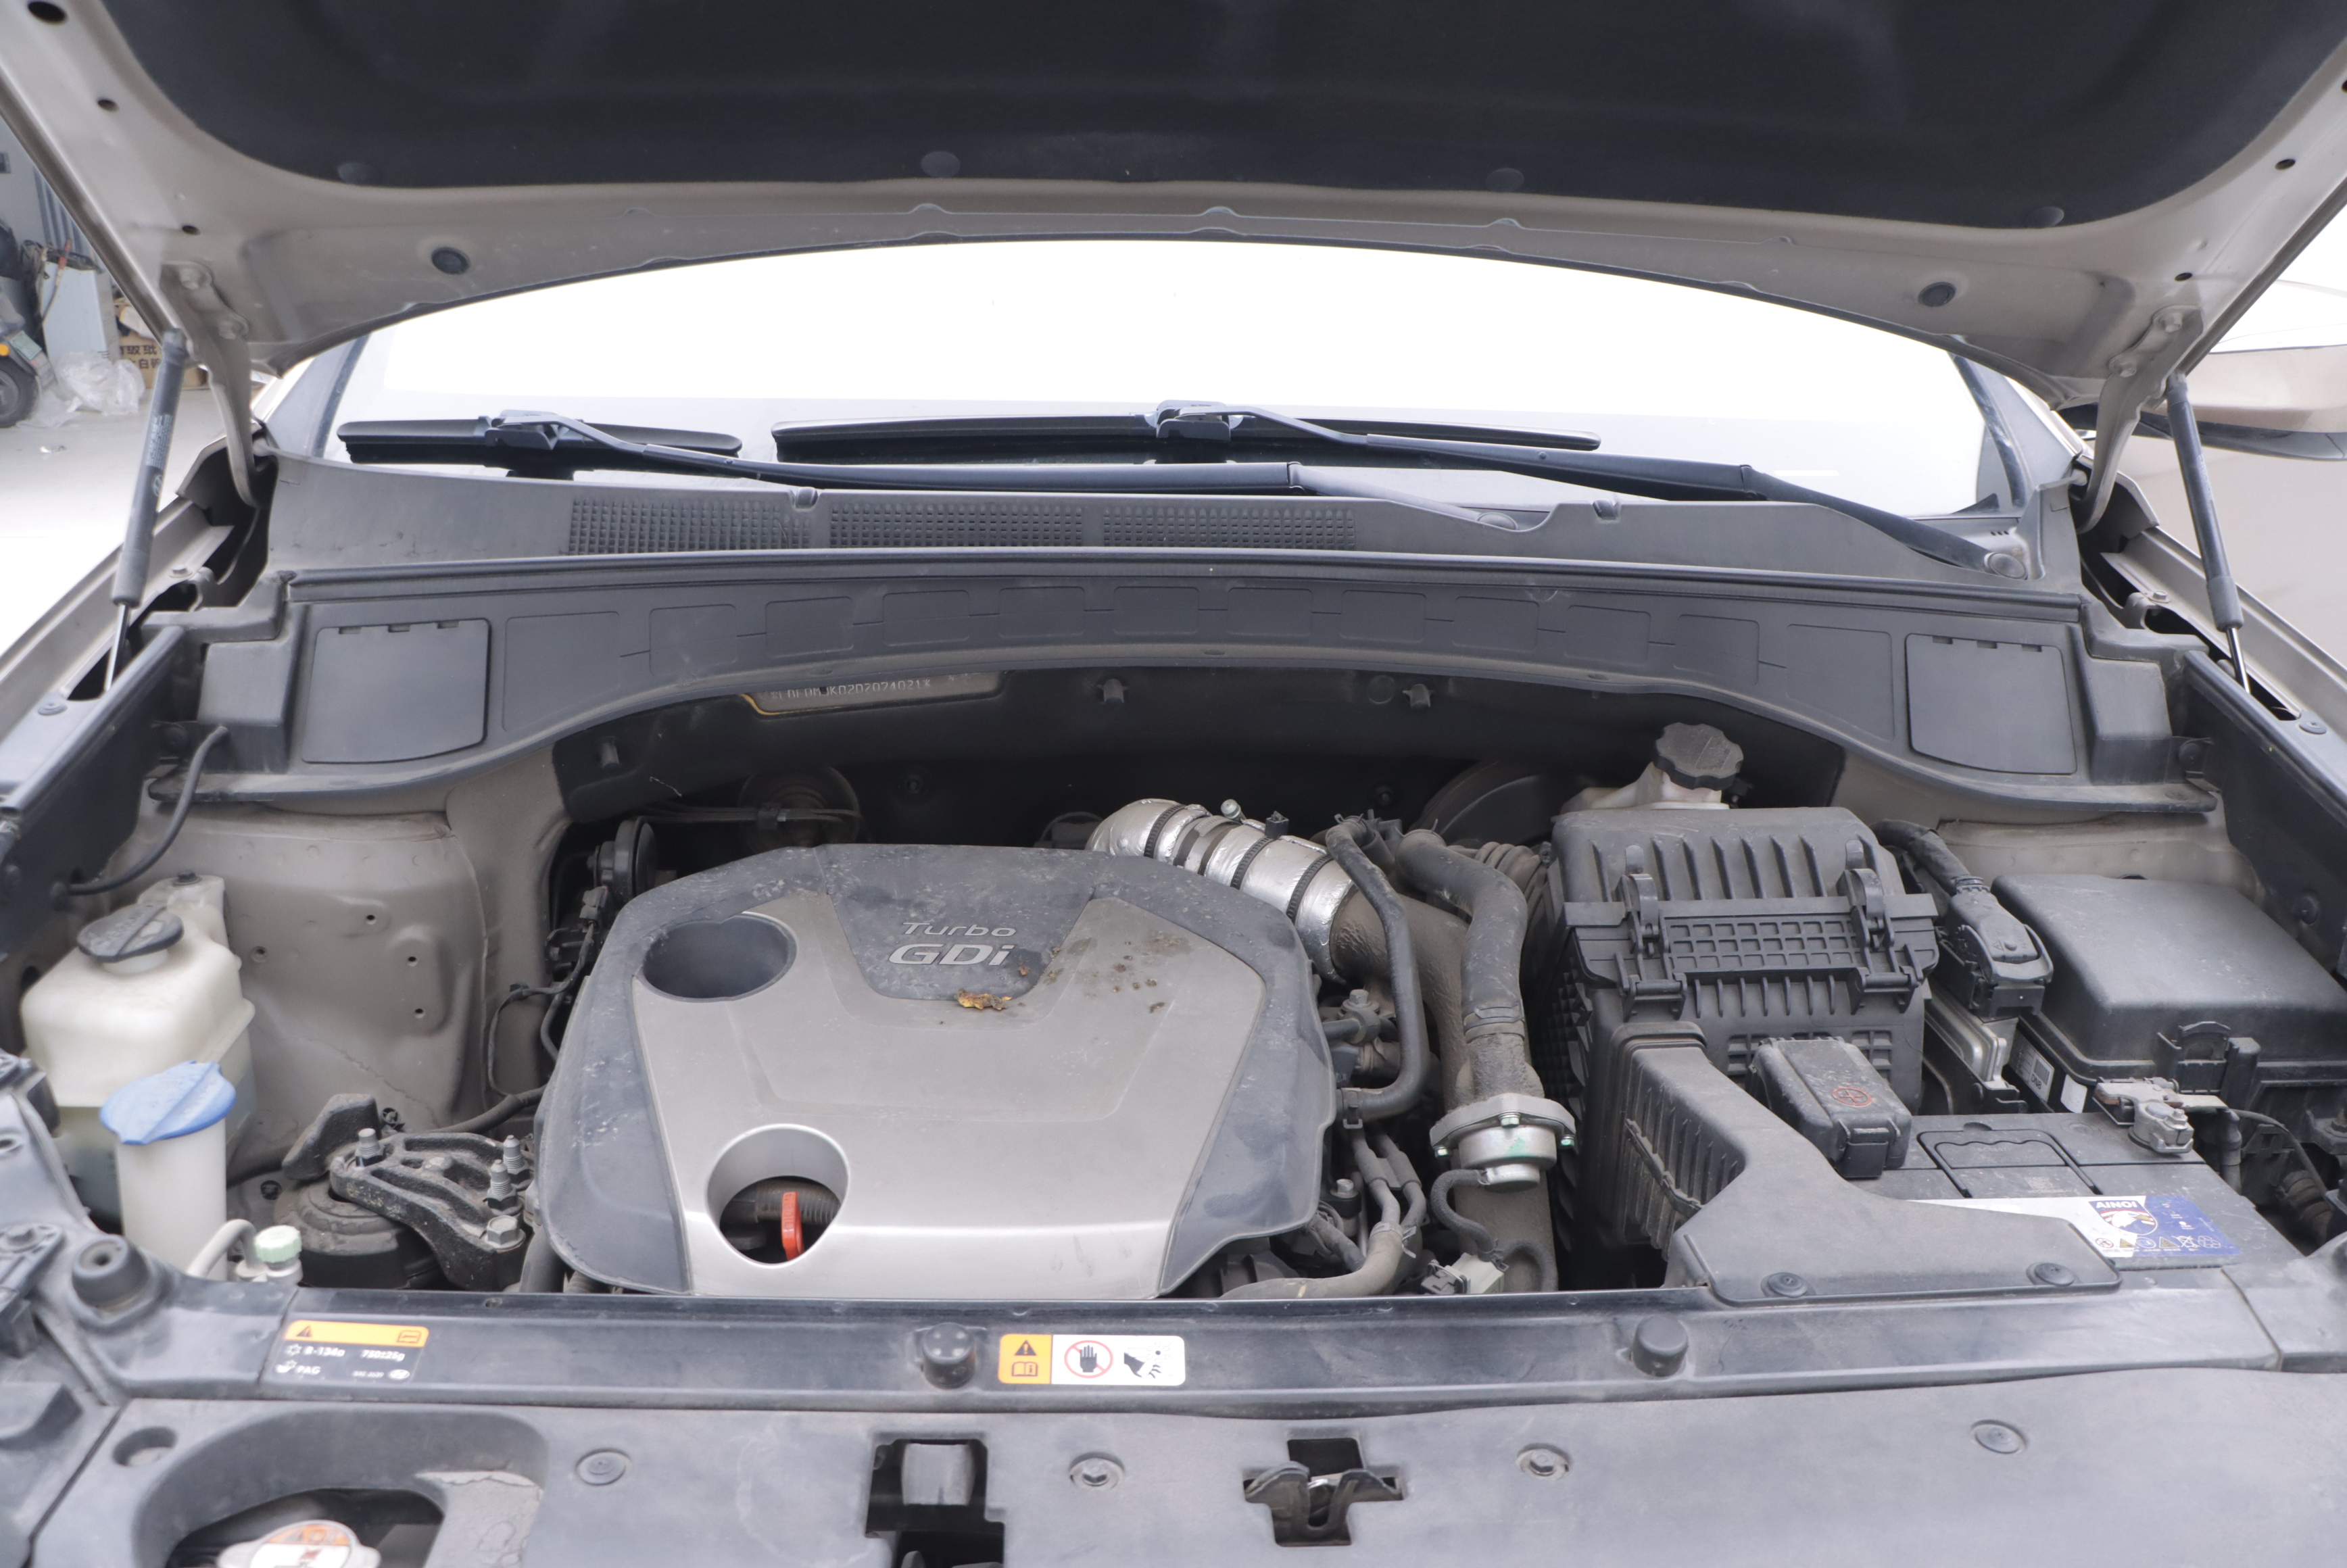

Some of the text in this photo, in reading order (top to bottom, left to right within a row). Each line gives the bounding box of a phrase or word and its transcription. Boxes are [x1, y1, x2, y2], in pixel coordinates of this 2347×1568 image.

[902, 922, 1017, 937] Turbo
[888, 943, 1015, 966] GDi
[303, 1346, 346, 1357] R-134a
[295, 1365, 321, 1375] PAG
